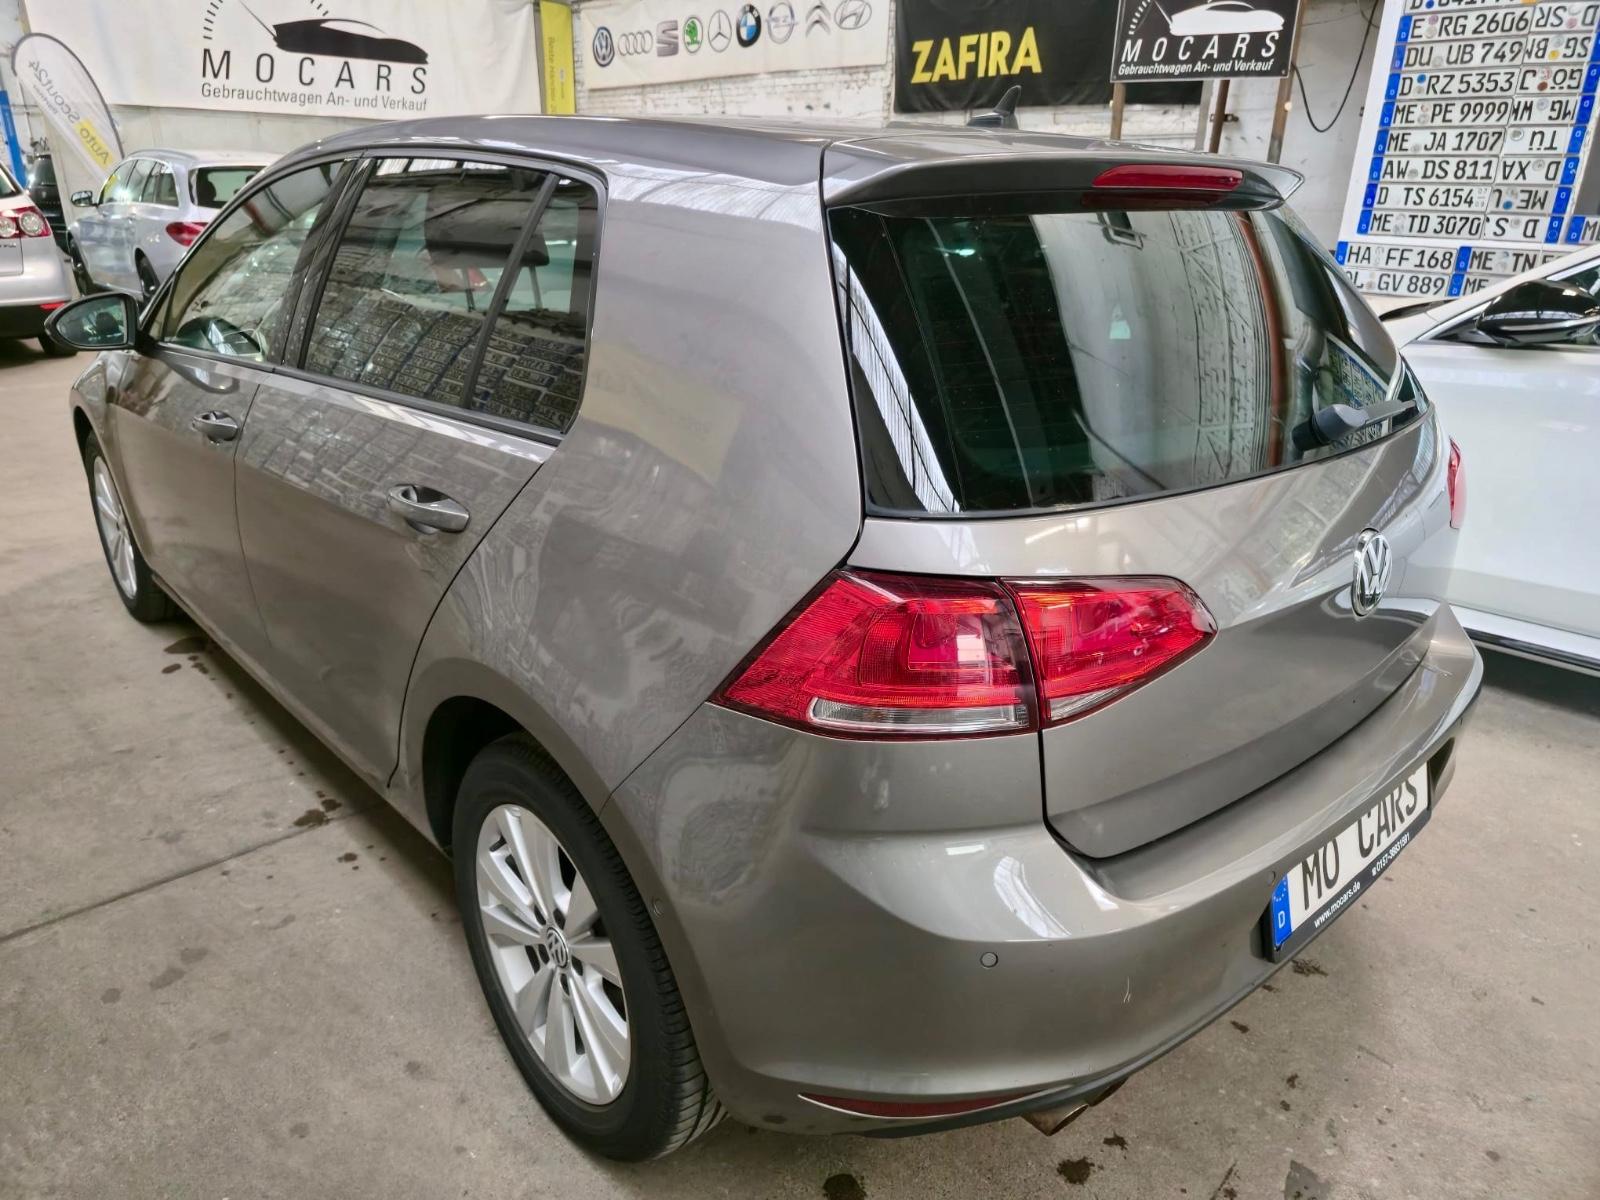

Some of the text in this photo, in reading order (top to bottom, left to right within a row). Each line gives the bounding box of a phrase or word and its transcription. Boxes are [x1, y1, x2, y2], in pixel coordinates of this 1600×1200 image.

[1411, 18, 1425, 38] E
[1438, 15, 1468, 37] RG
[1472, 11, 1529, 35] 2606
[1535, 4, 1598, 27] D SR
[911, 26, 1042, 84] ZAFIRA
[1121, 31, 1279, 62] MOCARS
[1404, 46, 1433, 67] DU
[1446, 44, 1475, 65] UB
[1480, 41, 1523, 63] 749
[1563, 37, 1591, 58] SG
[202, 48, 427, 94] MOCARS
[1118, 58, 1275, 76] Gebrauchtwagen An- und Verkauf
[1399, 77, 1413, 96] D
[1426, 74, 1455, 95] RZ
[1458, 71, 1514, 94] 5353
[1550, 68, 1583, 89] GÖ
[201, 82, 428, 111] Gebrauchtwagen An- und Verkauf
[1393, 104, 1417, 124] ME
[1430, 103, 1455, 123] PE
[1460, 101, 1509, 122] 9999
[1548, 99, 1577, 120] MG
[1387, 132, 1411, 152] ME
[1424, 132, 1446, 152] JA
[1452, 131, 1502, 152] 1707
[1528, 130, 1557, 150] TÜ
[1382, 160, 1409, 179] AW
[1422, 160, 1450, 179] DS
[1454, 160, 1493, 179] 811
[1503, 160, 1531, 180] XA
[1545, 160, 1561, 181] D
[1377, 187, 1389, 205] D
[1404, 187, 1425, 206] TS
[1429, 188, 1473, 208] 6154
[1516, 189, 1548, 210] ME
[1370, 213, 1394, 232] ME
[1409, 215, 1430, 233] TD
[1434, 216, 1481, 236] 3070
[1485, 217, 1509, 237] S
[1523, 219, 1540, 238] D
[1581, 221, 1600, 241] M
[1347, 246, 1371, 264] HA
[1385, 247, 1413, 266] FF
[1413, 249, 1453, 270] 168
[1469, 251, 1495, 270] ME
[1512, 253, 1537, 272] TN
[1377, 273, 1404, 292] GV
[1406, 275, 1446, 295] 889
[1301, 779, 1418, 910] MO CARS
[1314, 881, 1360, 928] www.mocars.de
[1278, 910, 1286, 928] D
